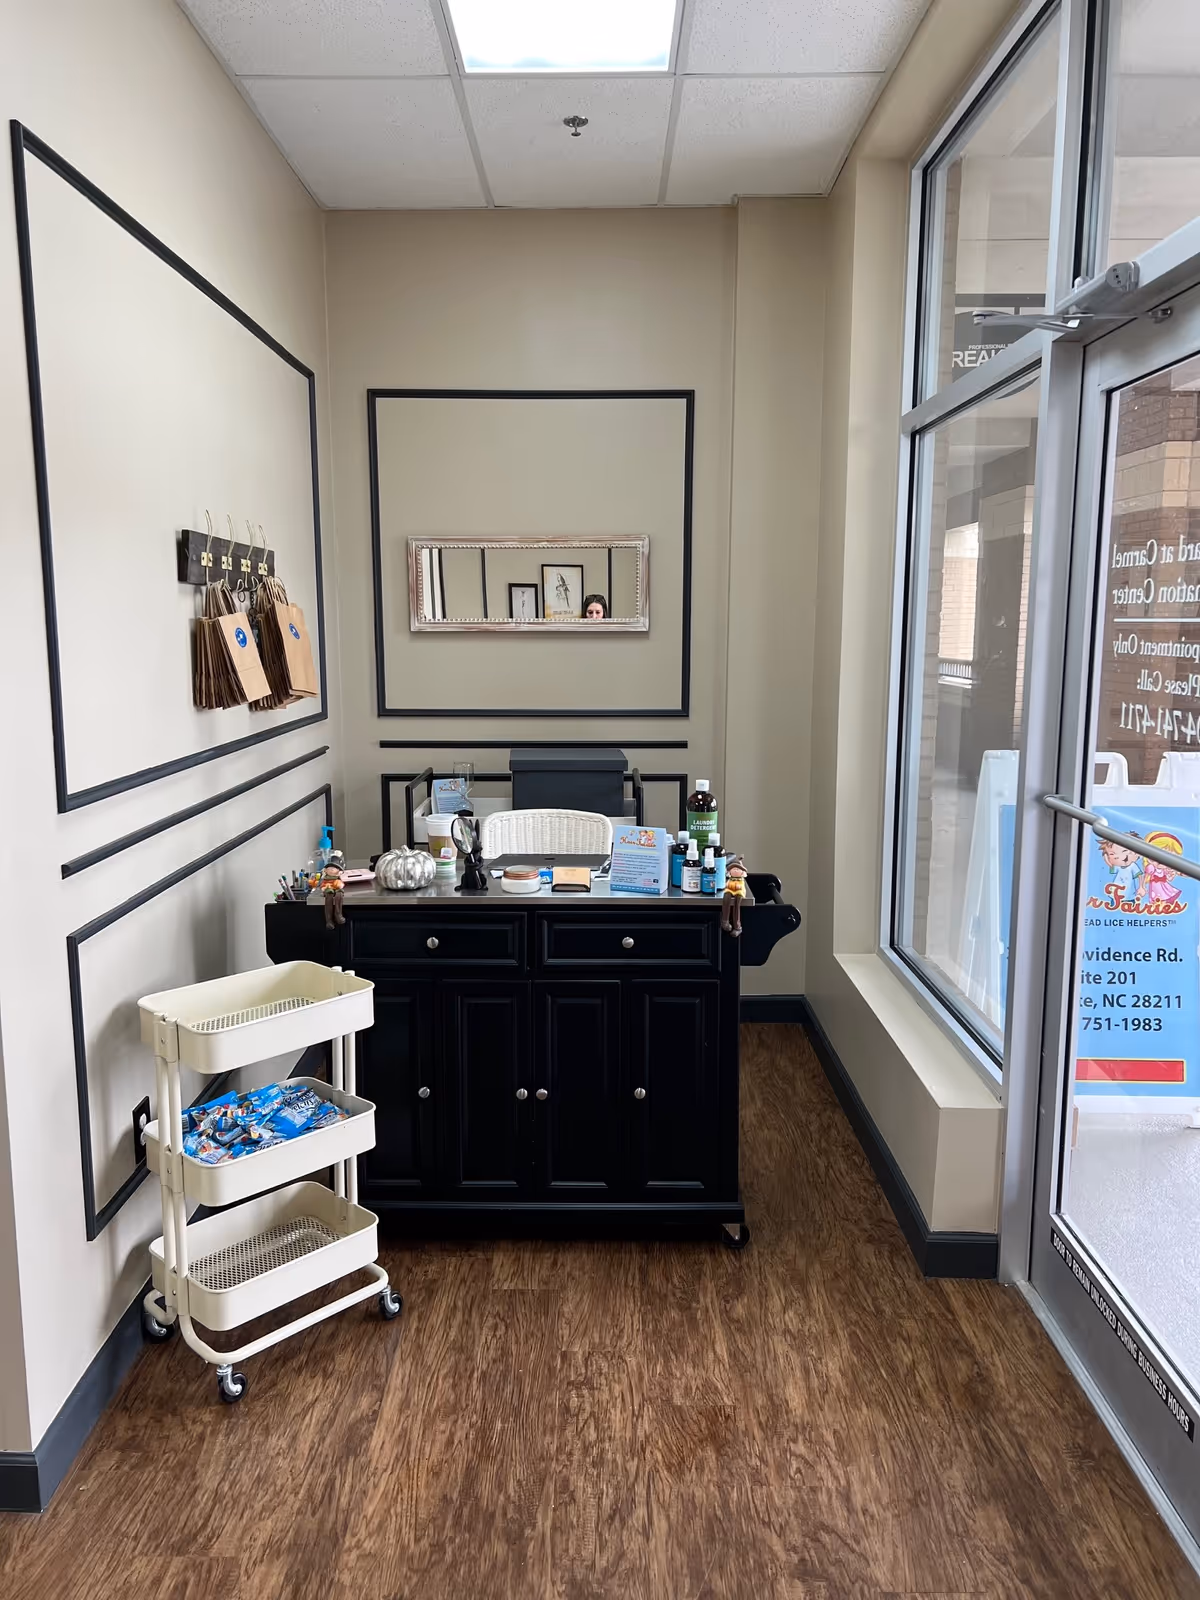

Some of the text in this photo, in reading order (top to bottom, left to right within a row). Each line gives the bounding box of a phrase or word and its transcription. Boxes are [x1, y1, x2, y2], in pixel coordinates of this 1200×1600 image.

[1104, 883, 1188, 915] Fairies
[1104, 919, 1124, 927] LICE
[1156, 948, 1184, 962] Rd.
[1106, 971, 1137, 985] 201
[1102, 993, 1127, 1008] NC
[1131, 994, 1182, 1009] 28211
[1082, 1017, 1163, 1032] 751-1983
[1053, 1232, 1190, 1432] DOOR TO REMAIN UNLOCKED DURING BUSINESS HOURS
